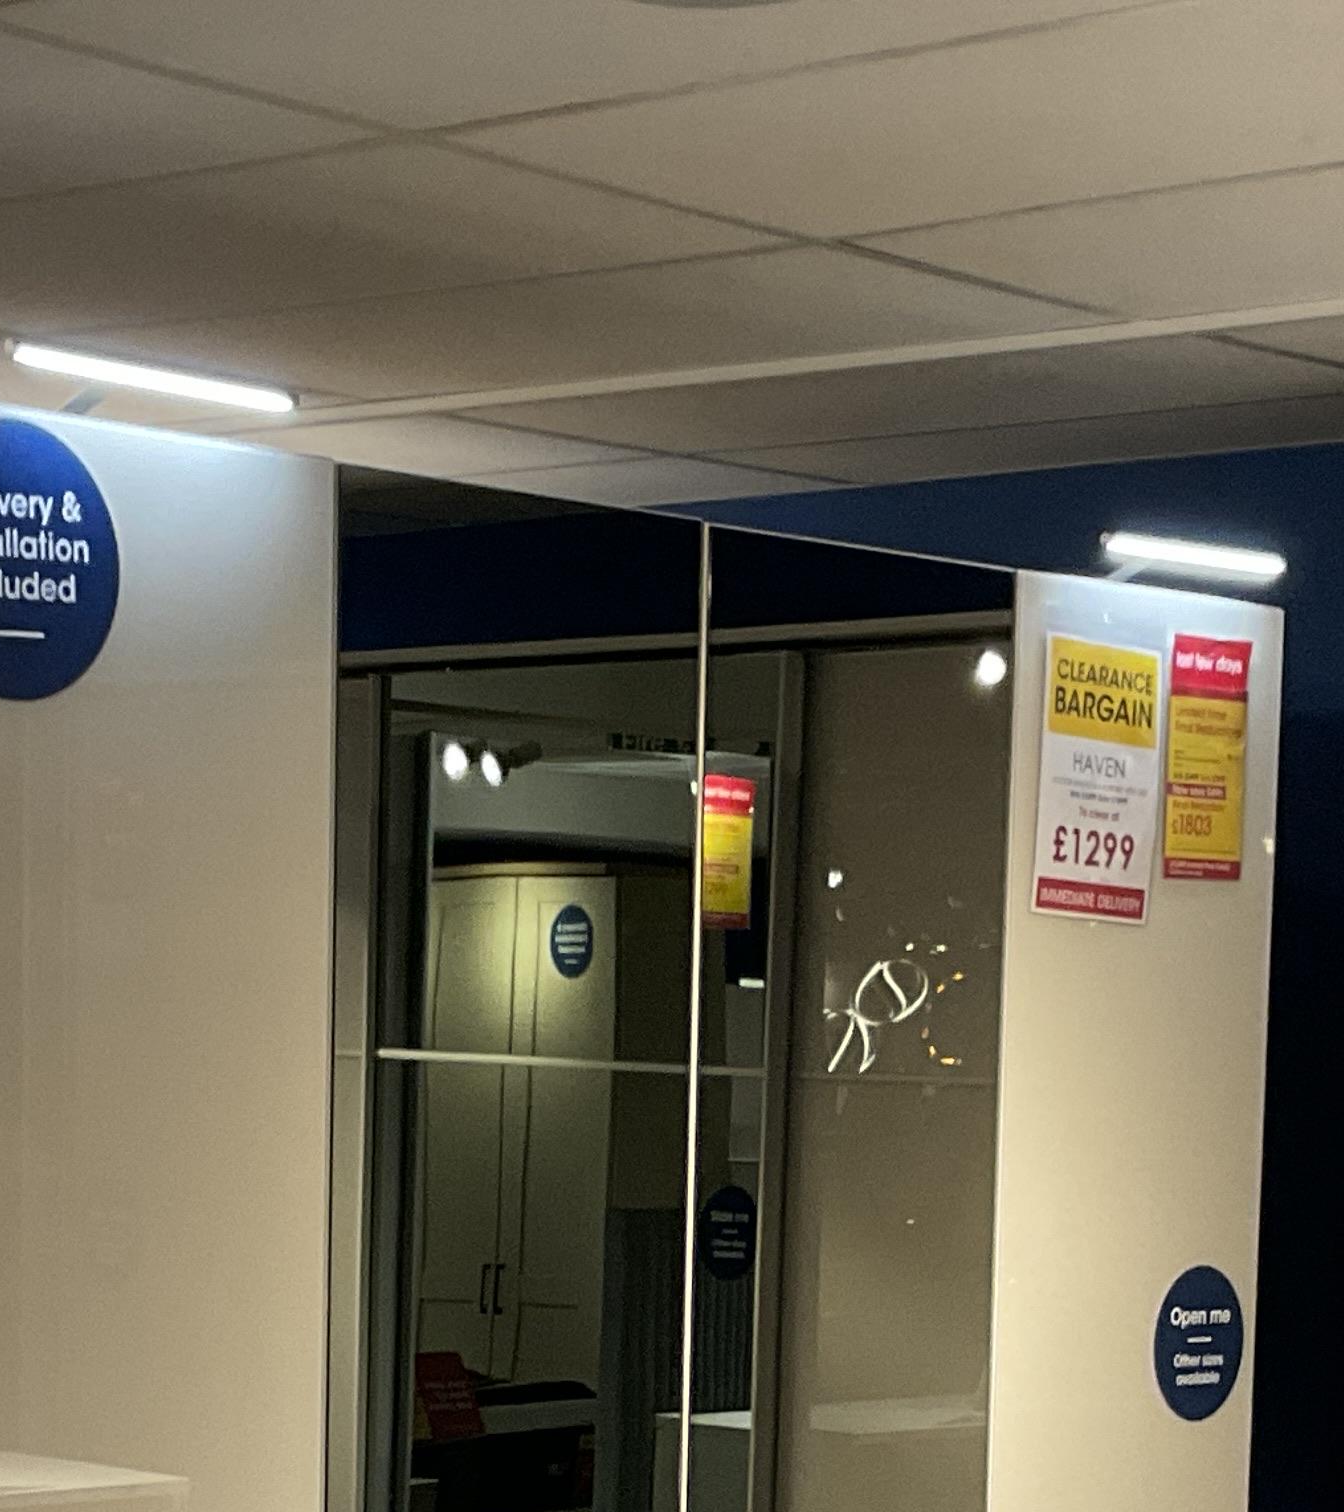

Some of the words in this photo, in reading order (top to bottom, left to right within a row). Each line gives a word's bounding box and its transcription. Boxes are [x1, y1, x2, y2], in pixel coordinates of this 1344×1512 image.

[62, 491, 82, 524] &
[1057, 658, 1153, 697] CLEARANCE
[1055, 685, 1153, 729] BARGAIN
[1072, 752, 1127, 778] HAVEN
[1053, 825, 1135, 871] £1299
[1170, 1306, 1206, 1330] Open
[1209, 1308, 1231, 1325] me
